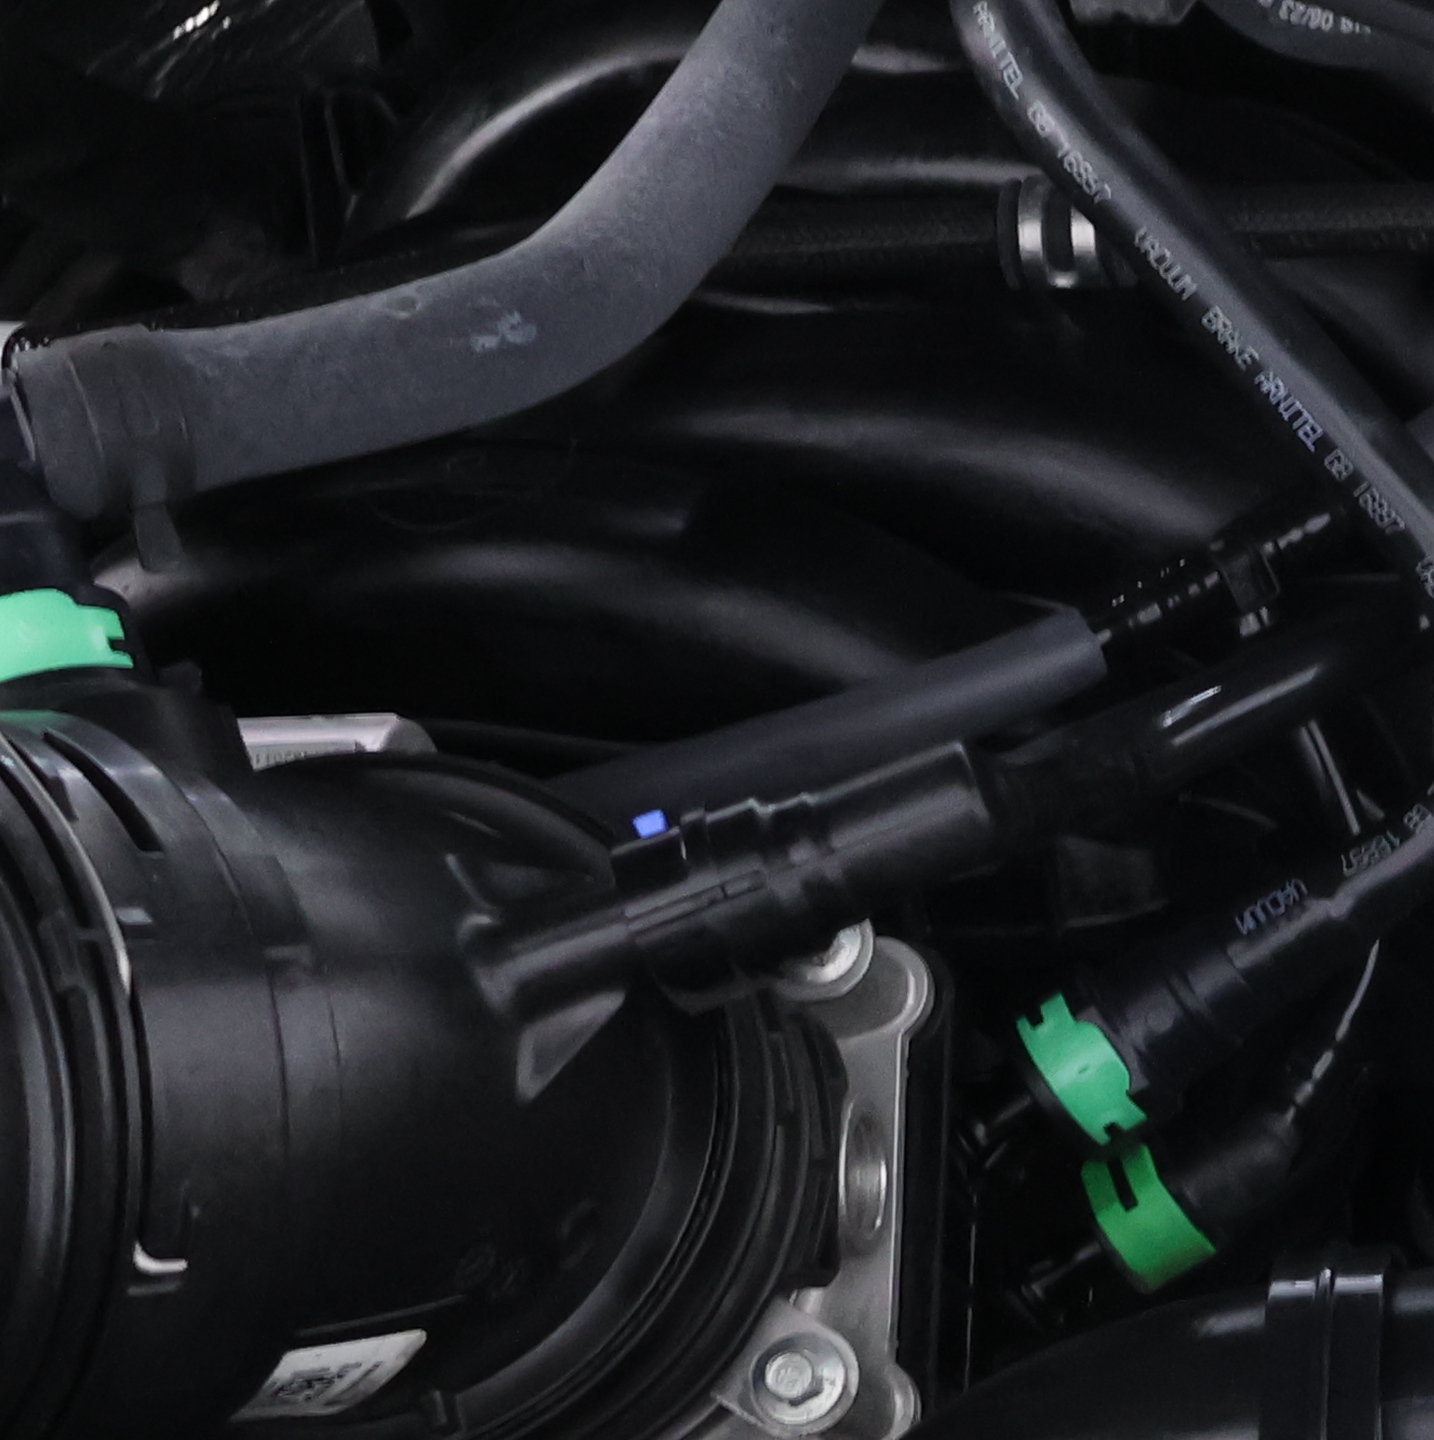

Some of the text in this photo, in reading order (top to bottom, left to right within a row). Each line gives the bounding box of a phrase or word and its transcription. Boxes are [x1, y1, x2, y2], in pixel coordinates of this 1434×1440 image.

[1132, 226, 1199, 302] VACUUM
[1200, 304, 1260, 372] BRAKE
[1254, 365, 1325, 455] ARNITEL
[1233, 876, 1310, 936] VACUUM
